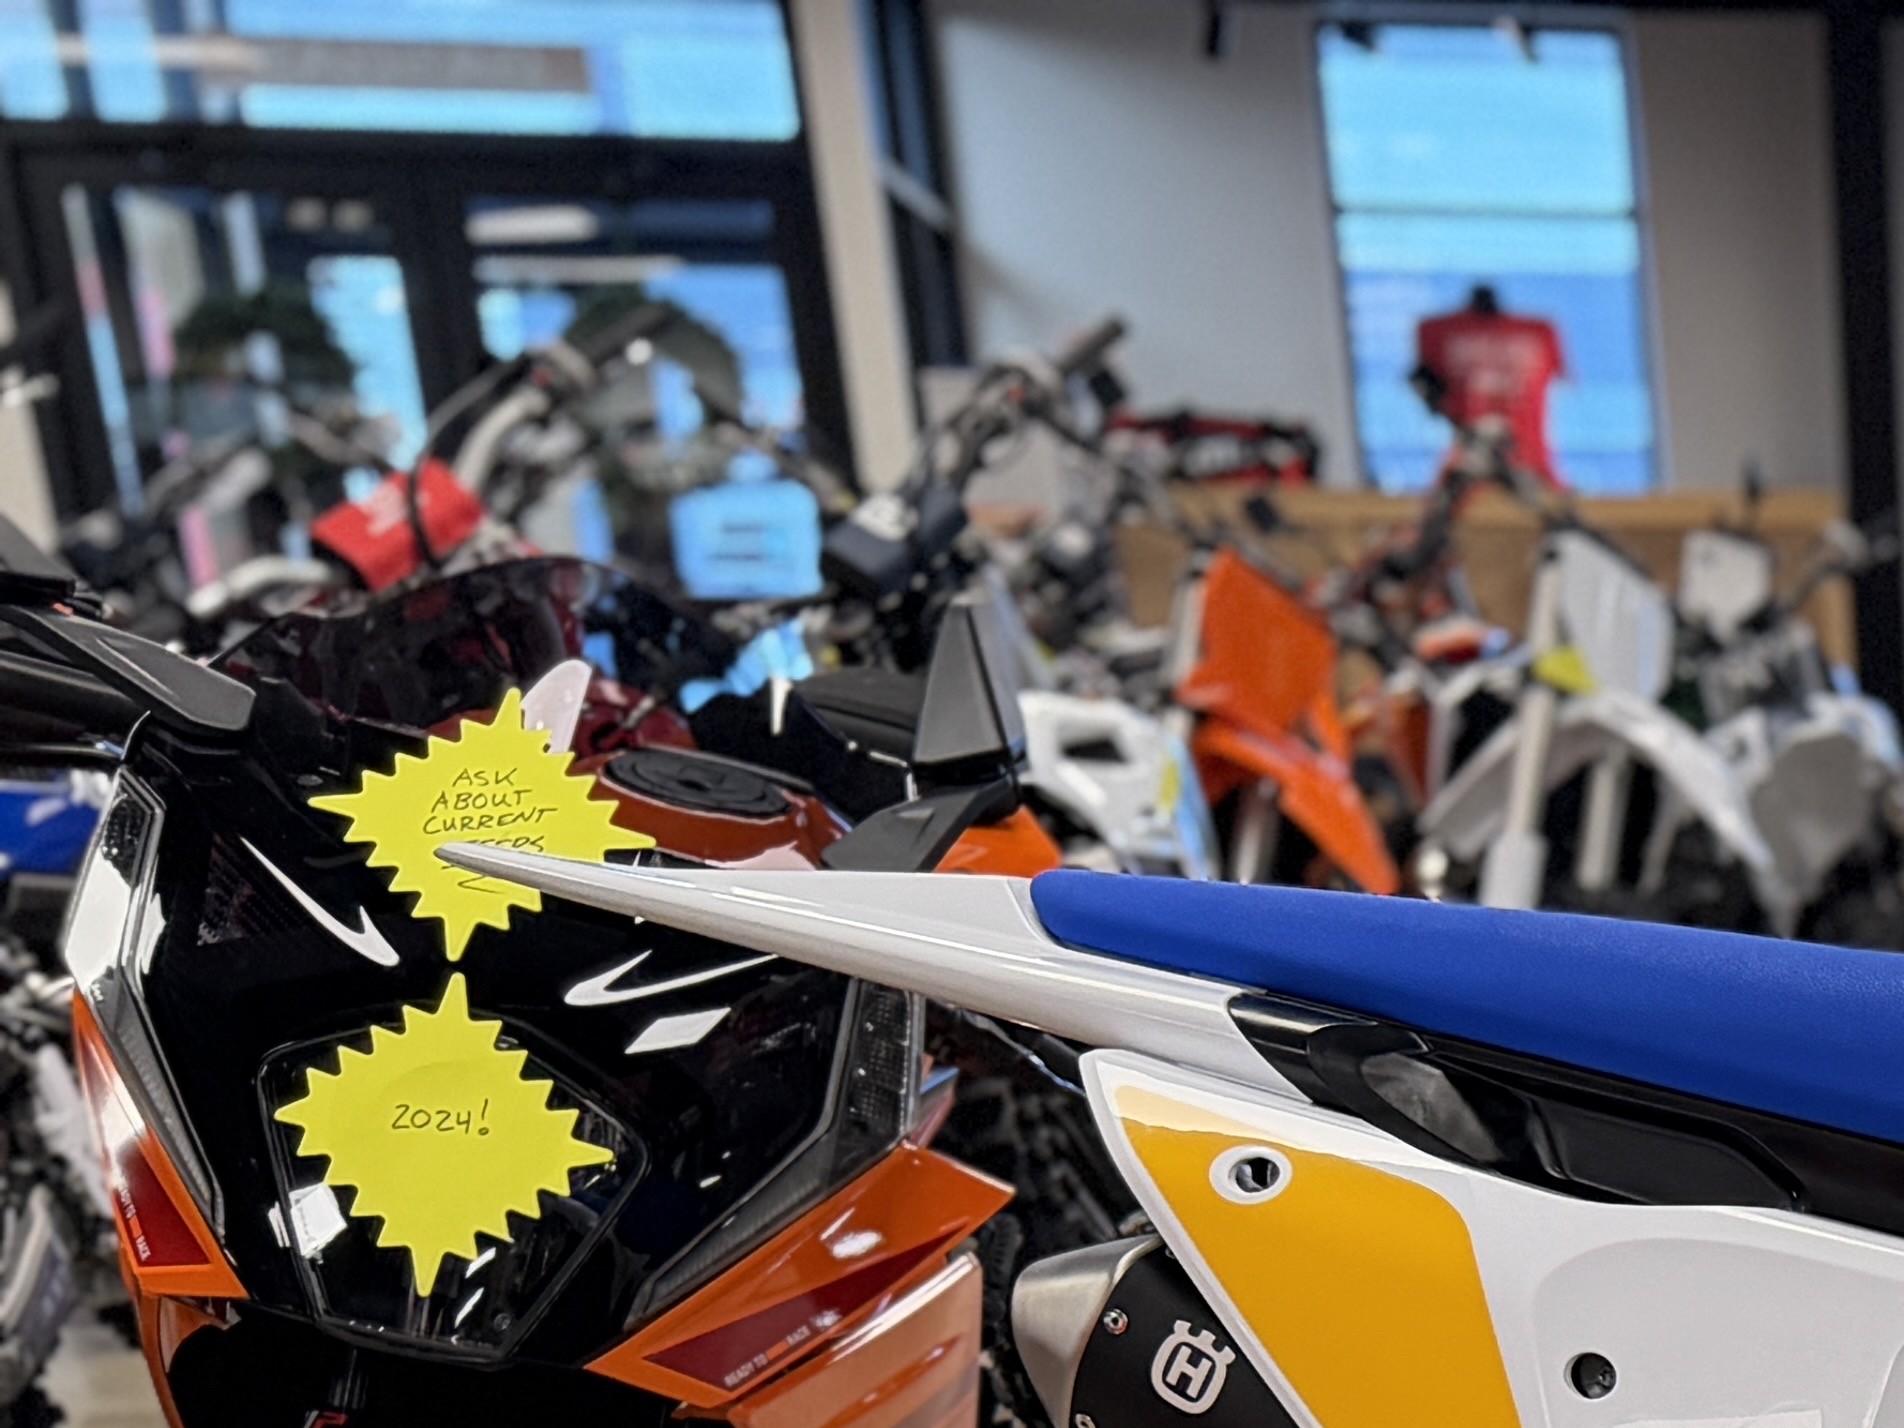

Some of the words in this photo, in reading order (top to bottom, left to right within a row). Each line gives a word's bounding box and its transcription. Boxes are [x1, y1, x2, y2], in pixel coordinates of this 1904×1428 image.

[452, 768, 518, 787] ASK
[430, 789, 533, 813] ABOUT
[422, 807, 559, 834] CURRENT
[391, 1098, 490, 1136] 2024!
